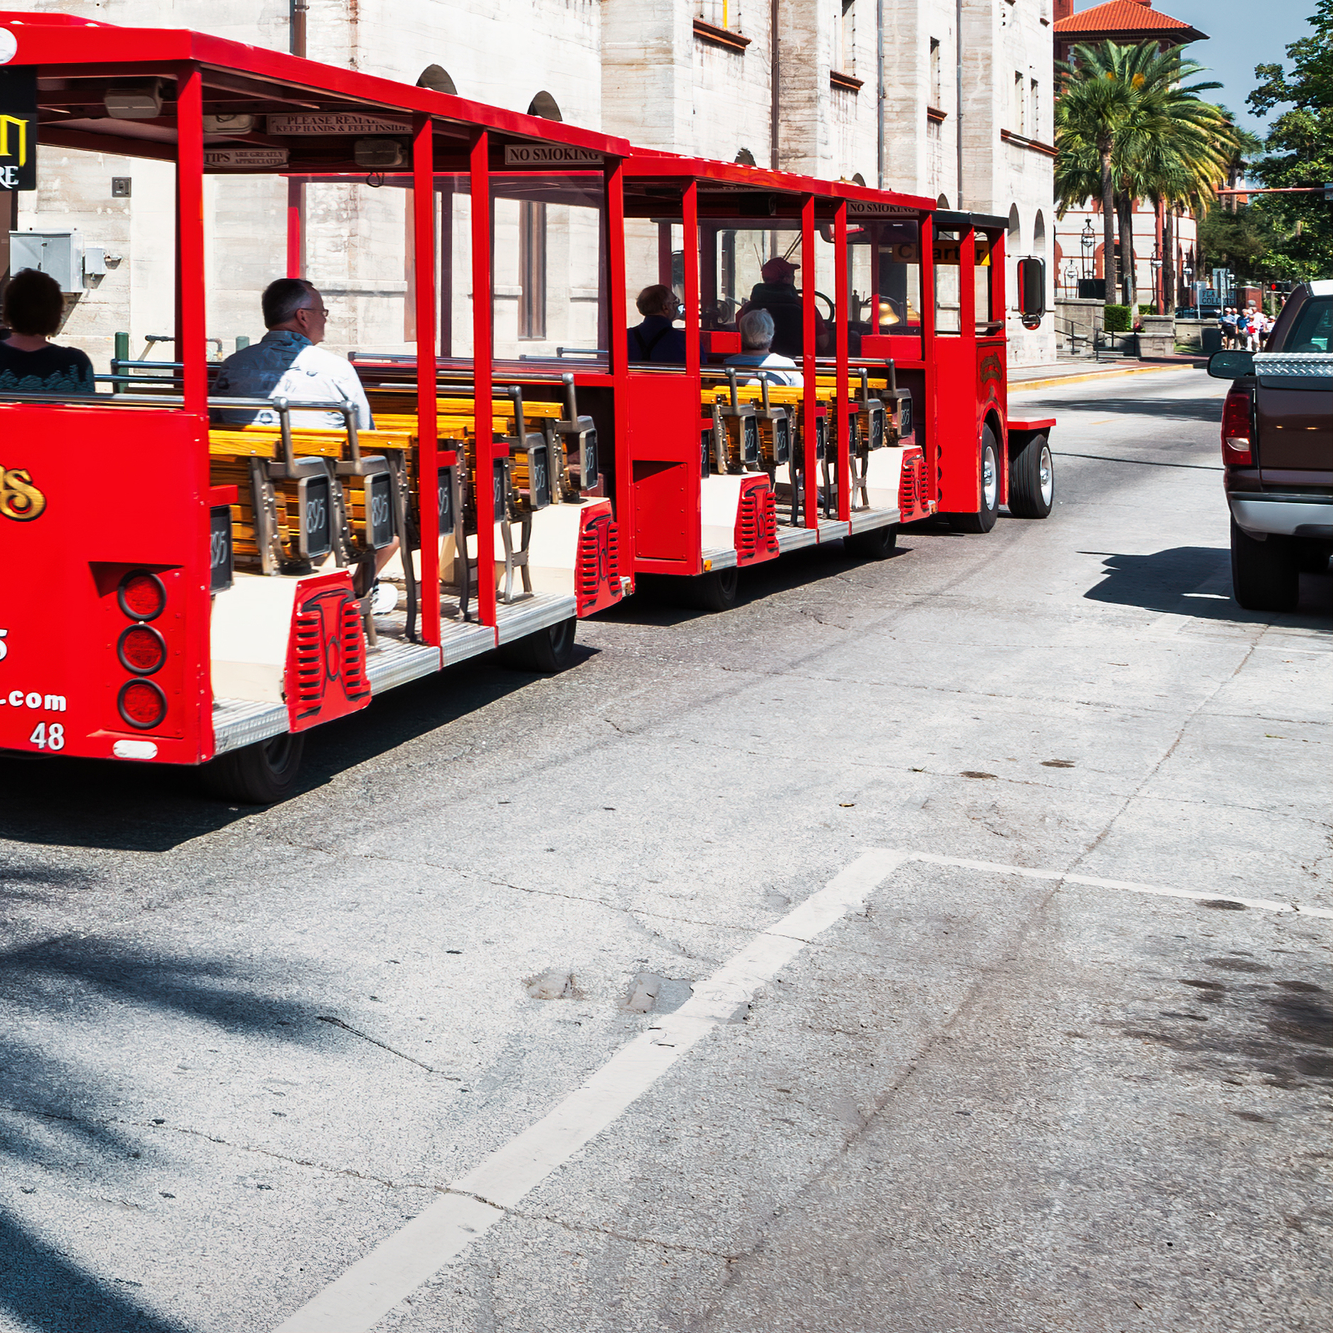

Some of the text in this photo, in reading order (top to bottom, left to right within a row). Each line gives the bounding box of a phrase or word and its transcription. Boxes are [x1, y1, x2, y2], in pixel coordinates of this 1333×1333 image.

[287, 116, 333, 125] PLEASE
[276, 125, 303, 133] KEEP
[204, 152, 231, 163] TIPS
[510, 148, 599, 161] NO SMOKING
[850, 203, 865, 213] NO
[898, 243, 984, 262] Cartr
[29, 721, 65, 751] 48
